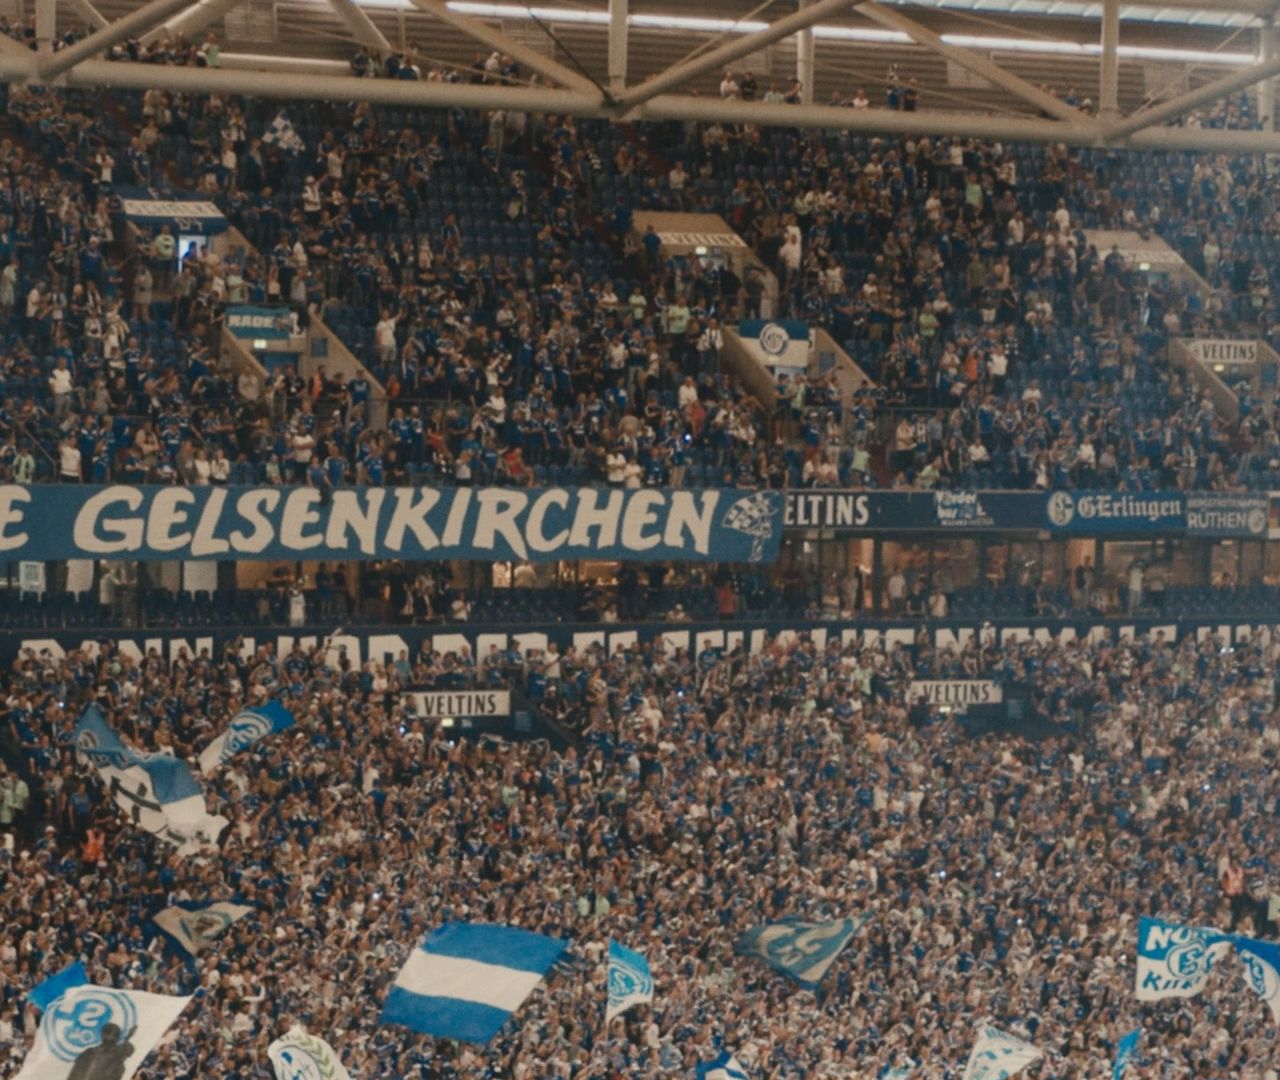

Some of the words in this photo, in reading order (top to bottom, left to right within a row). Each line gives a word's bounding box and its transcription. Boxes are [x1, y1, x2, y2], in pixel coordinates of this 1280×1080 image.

[1202, 343, 1255, 360] VELTINS
[782, 494, 870, 526] ELTINS
[73, 486, 720, 560] GELSENKIRCHEN
[923, 682, 990, 704] VELTINS
[423, 694, 496, 716] VELTINS
